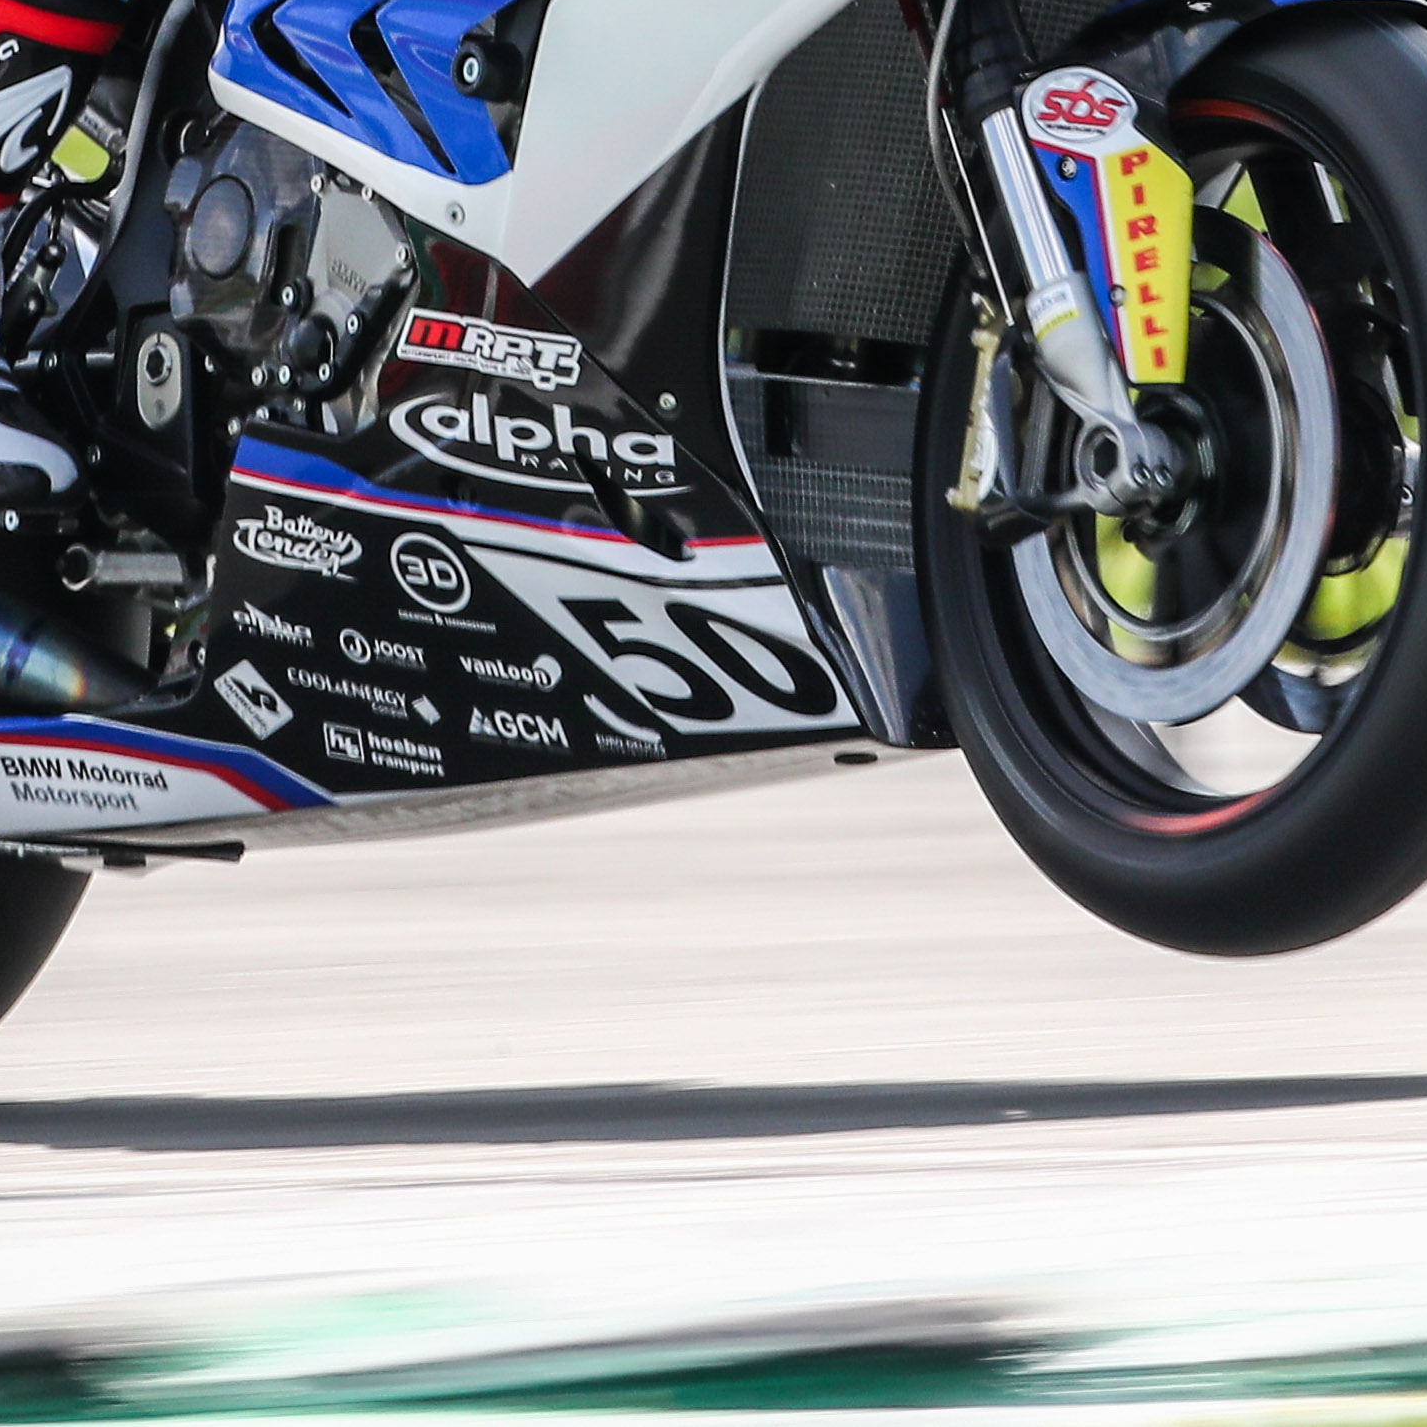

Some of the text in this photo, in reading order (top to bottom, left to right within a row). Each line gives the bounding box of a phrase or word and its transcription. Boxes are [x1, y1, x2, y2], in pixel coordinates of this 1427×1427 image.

[1119, 150, 1169, 370] PIRELLI
[421, 392, 676, 467] alpha
[521, 453, 676, 484] RAING
[264, 504, 354, 553] Battery
[235, 519, 342, 576] Tender
[399, 553, 459, 590] 3D
[373, 638, 425, 665] JOOST
[560, 596, 838, 722] 50
[459, 655, 550, 686] vanLoon
[367, 730, 442, 762] hoeben
[493, 709, 570, 748] GCM
[0, 755, 169, 790] BMW Motorrad
[372, 751, 445, 777] transport
[9, 780, 140, 813] Motorsport
